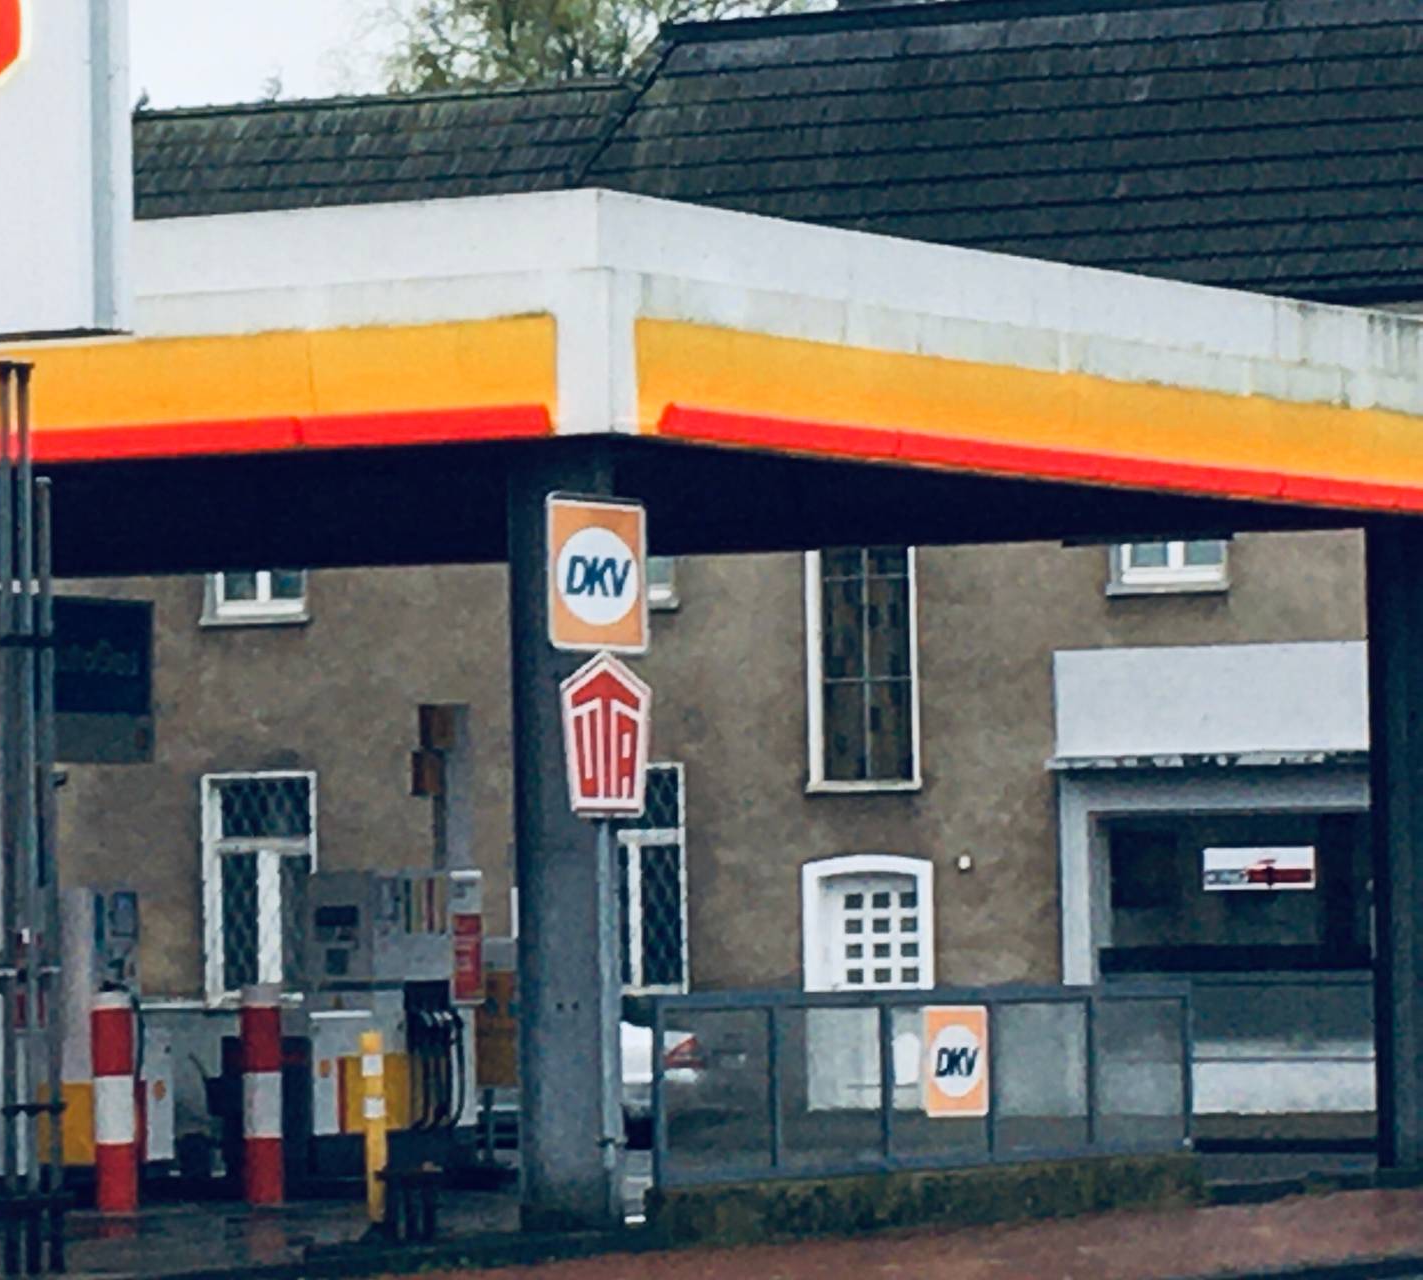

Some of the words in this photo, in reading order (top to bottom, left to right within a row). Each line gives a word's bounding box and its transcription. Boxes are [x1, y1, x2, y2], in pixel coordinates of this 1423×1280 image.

[565, 555, 632, 597] DKV
[569, 668, 639, 800] UTA
[935, 1047, 979, 1077] DKV
